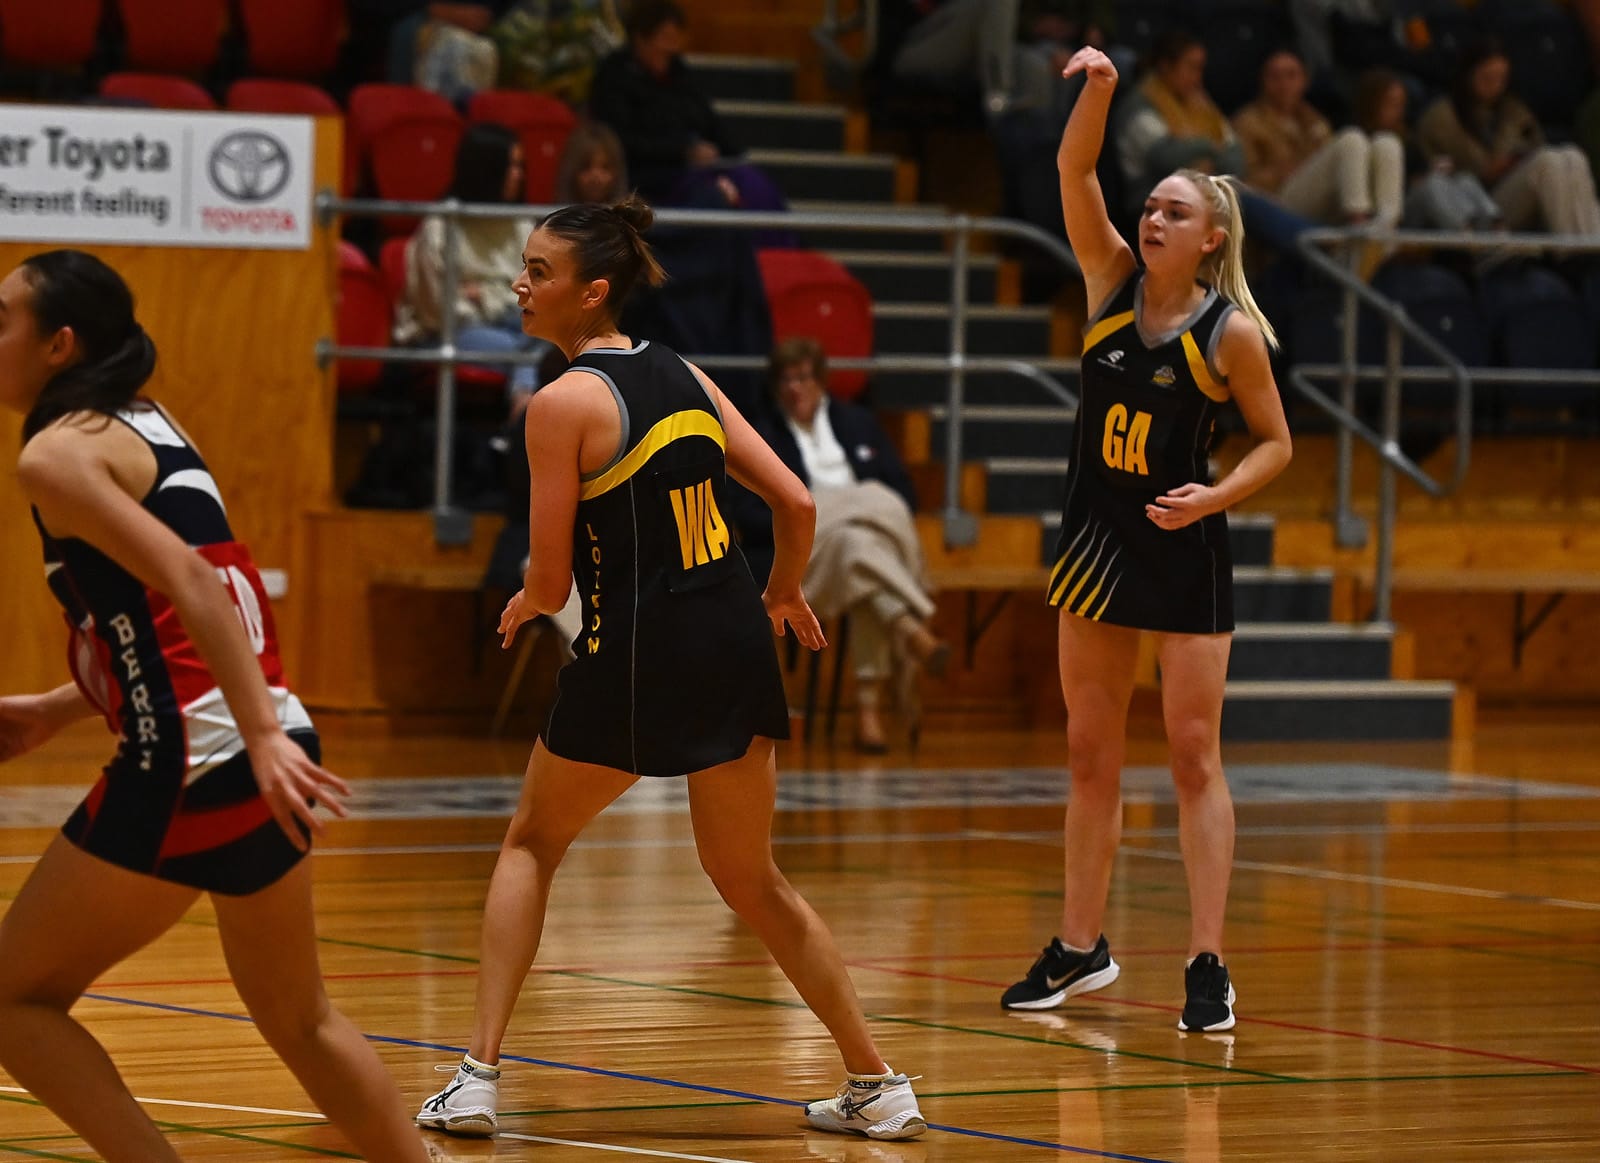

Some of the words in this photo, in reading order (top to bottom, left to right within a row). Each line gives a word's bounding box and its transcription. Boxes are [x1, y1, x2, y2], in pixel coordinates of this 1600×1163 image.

[42, 126, 170, 181] Toyota
[81, 187, 168, 226] feeling
[201, 206, 295, 232] TOYOTA
[1102, 402, 1153, 476] GA
[669, 478, 730, 571] WA
